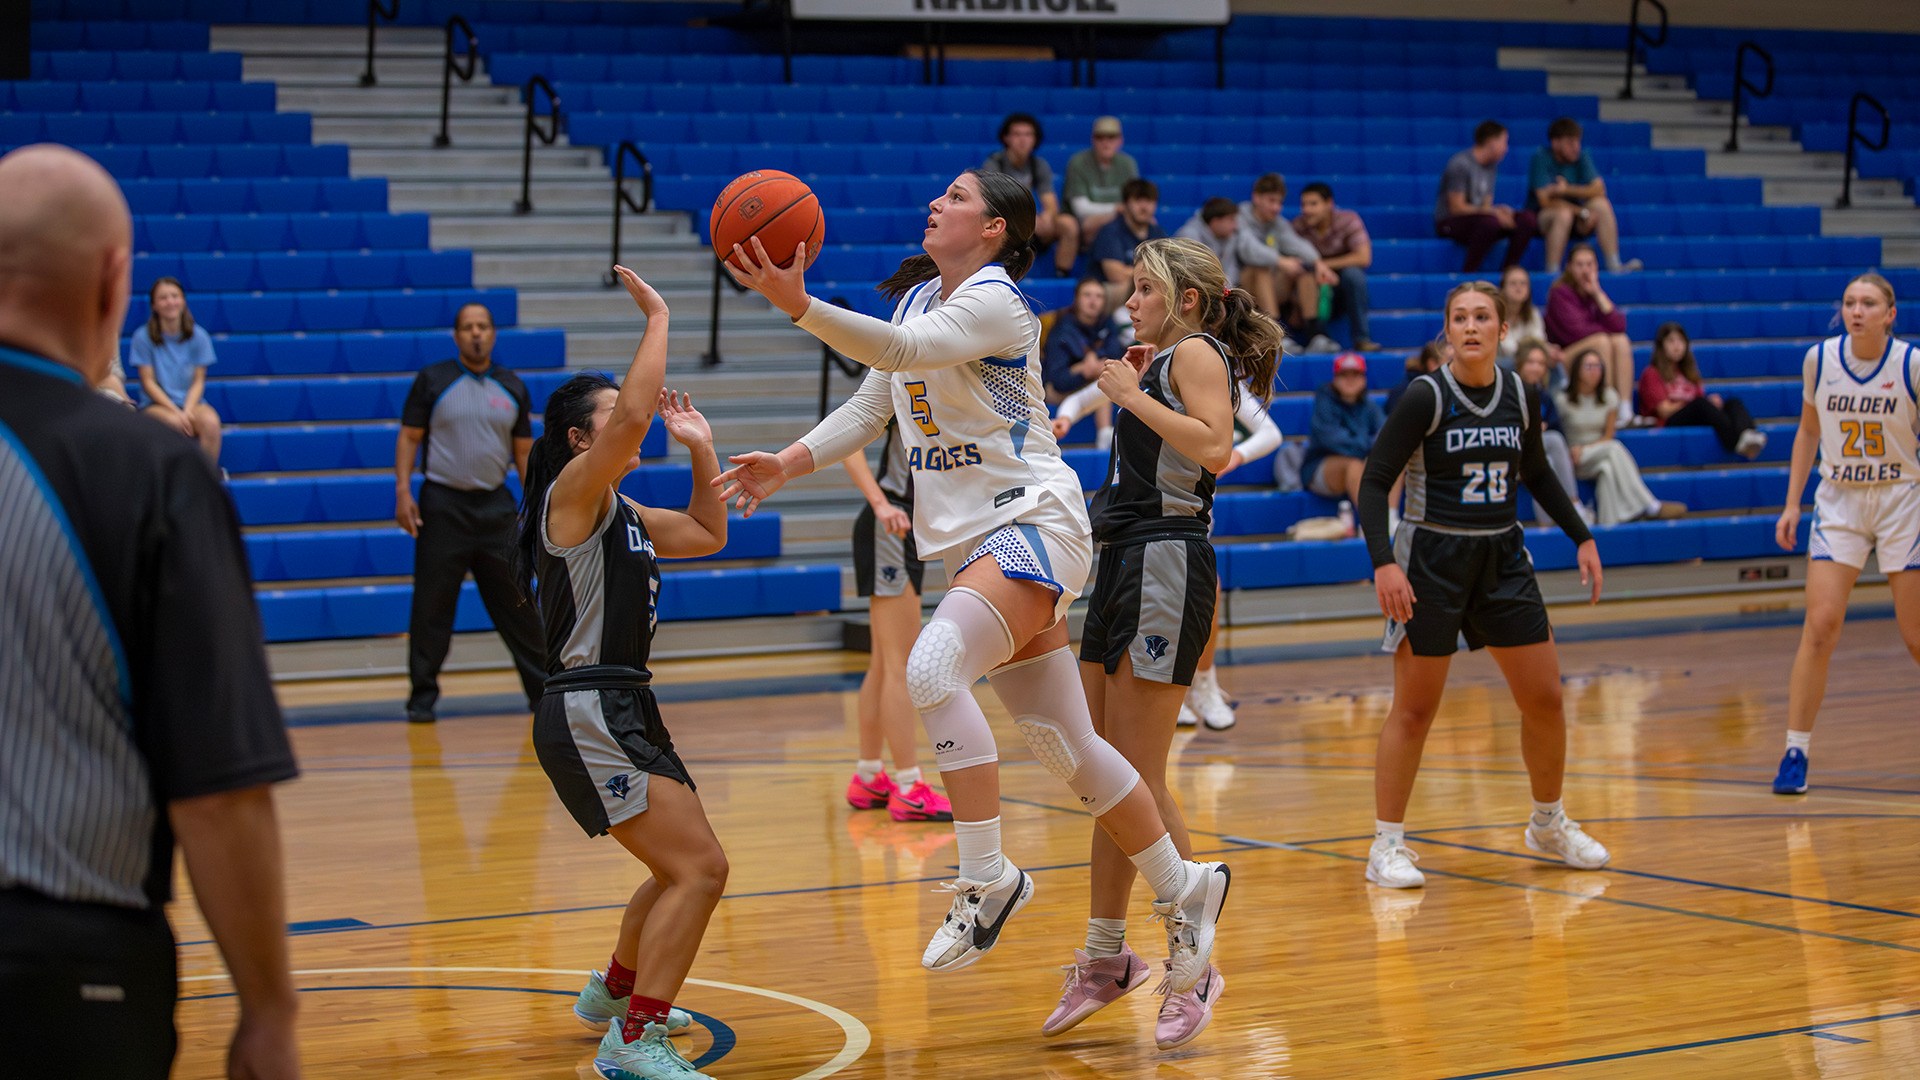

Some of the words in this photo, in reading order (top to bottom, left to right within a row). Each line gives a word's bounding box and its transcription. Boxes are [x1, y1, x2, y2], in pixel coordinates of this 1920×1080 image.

[904, 381, 940, 437] 5
[1826, 394, 1898, 415] GOLDEN
[1446, 426, 1522, 453] OZARK
[1840, 419, 1886, 458] 25
[905, 442, 983, 472] AGLES
[1460, 461, 1510, 504] 20
[1831, 463, 1902, 483] EAGLES
